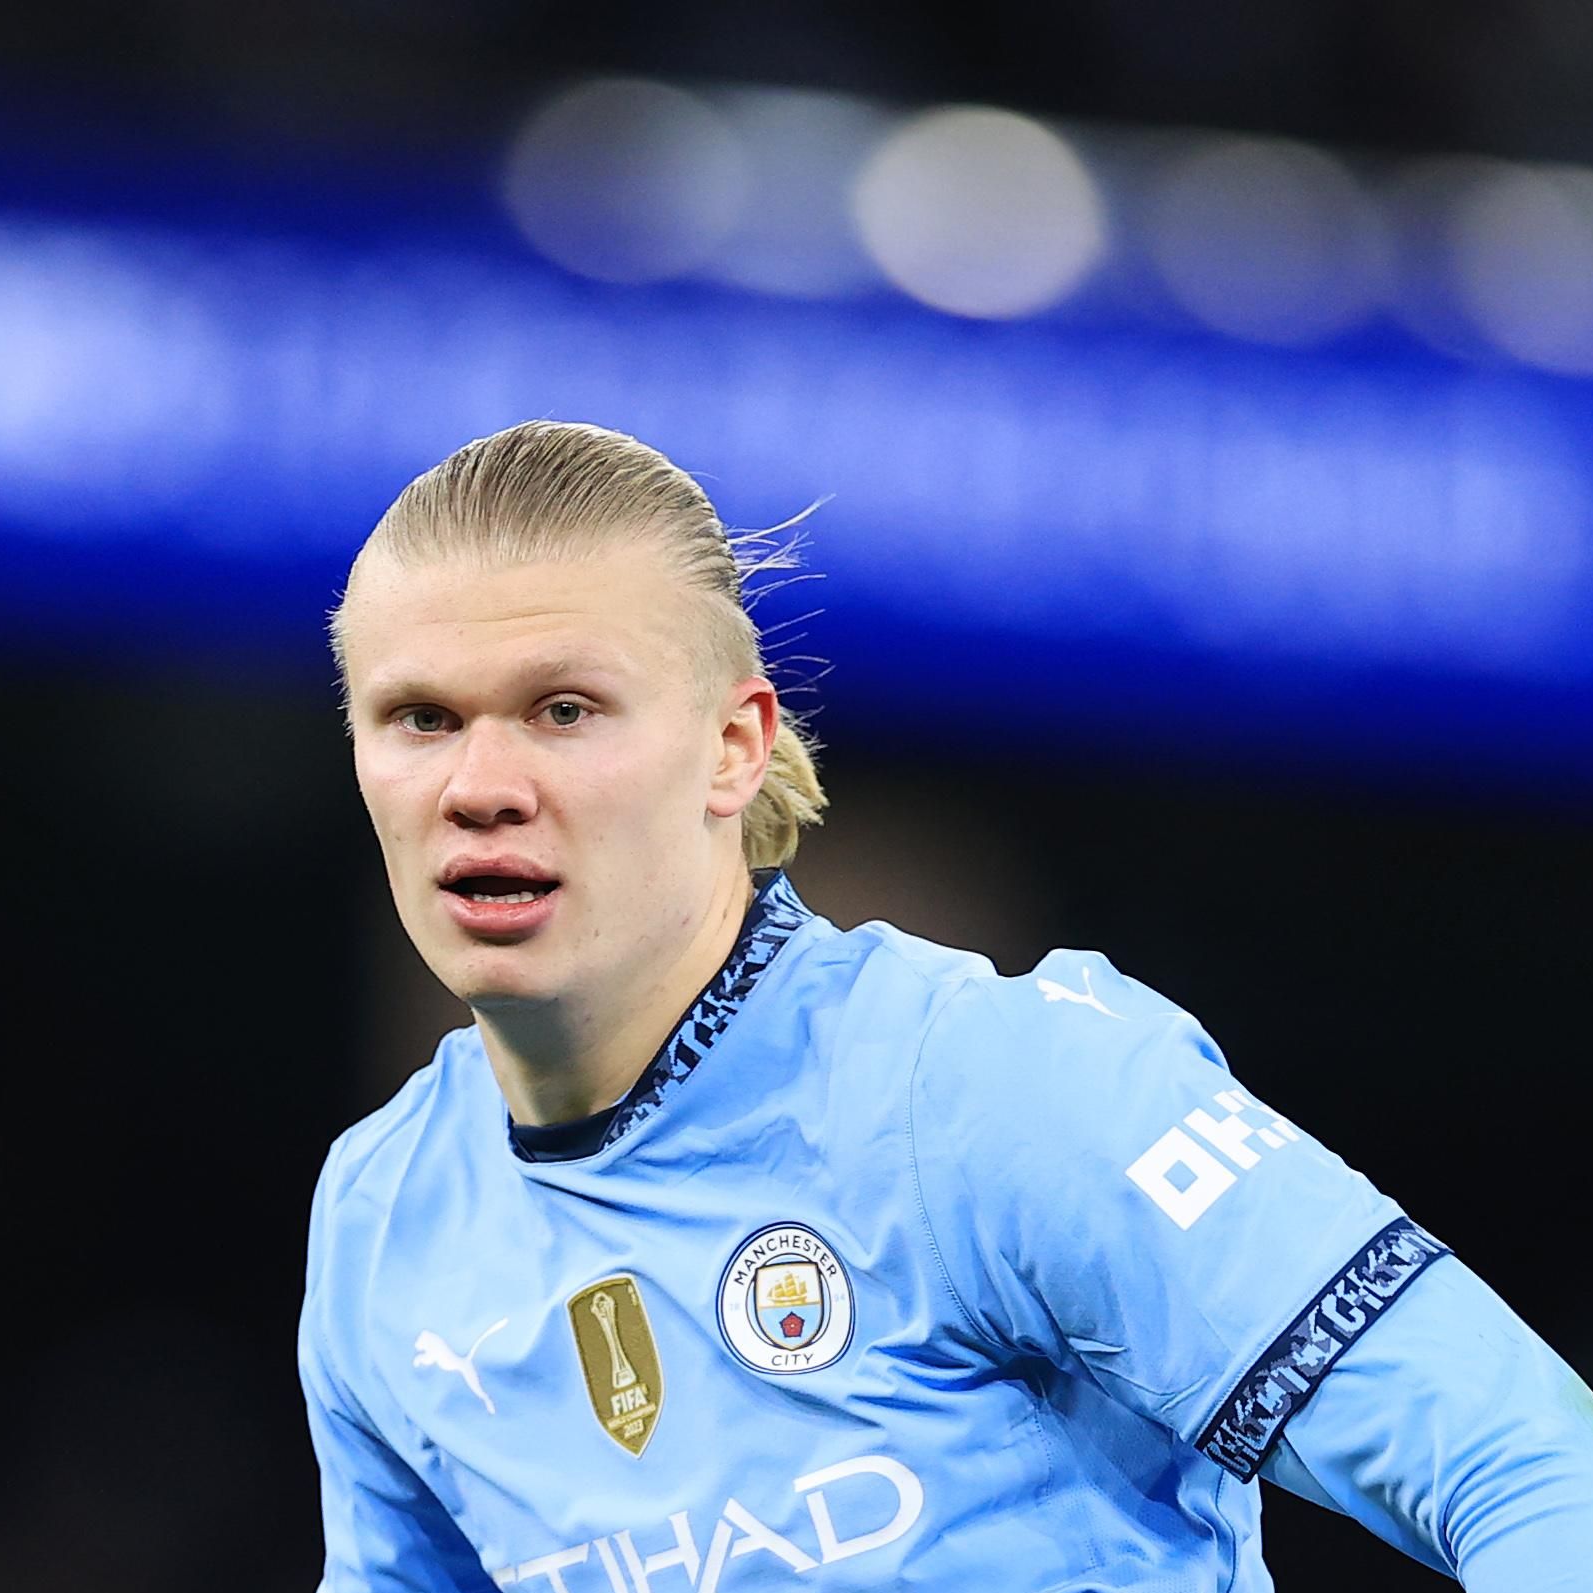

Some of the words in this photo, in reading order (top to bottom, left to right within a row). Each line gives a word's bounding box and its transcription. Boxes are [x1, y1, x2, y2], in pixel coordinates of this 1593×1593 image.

[733, 1234, 838, 1286] MANCHESTER
[770, 1353, 815, 1367] CITY
[610, 1385, 648, 1417] FIFA
